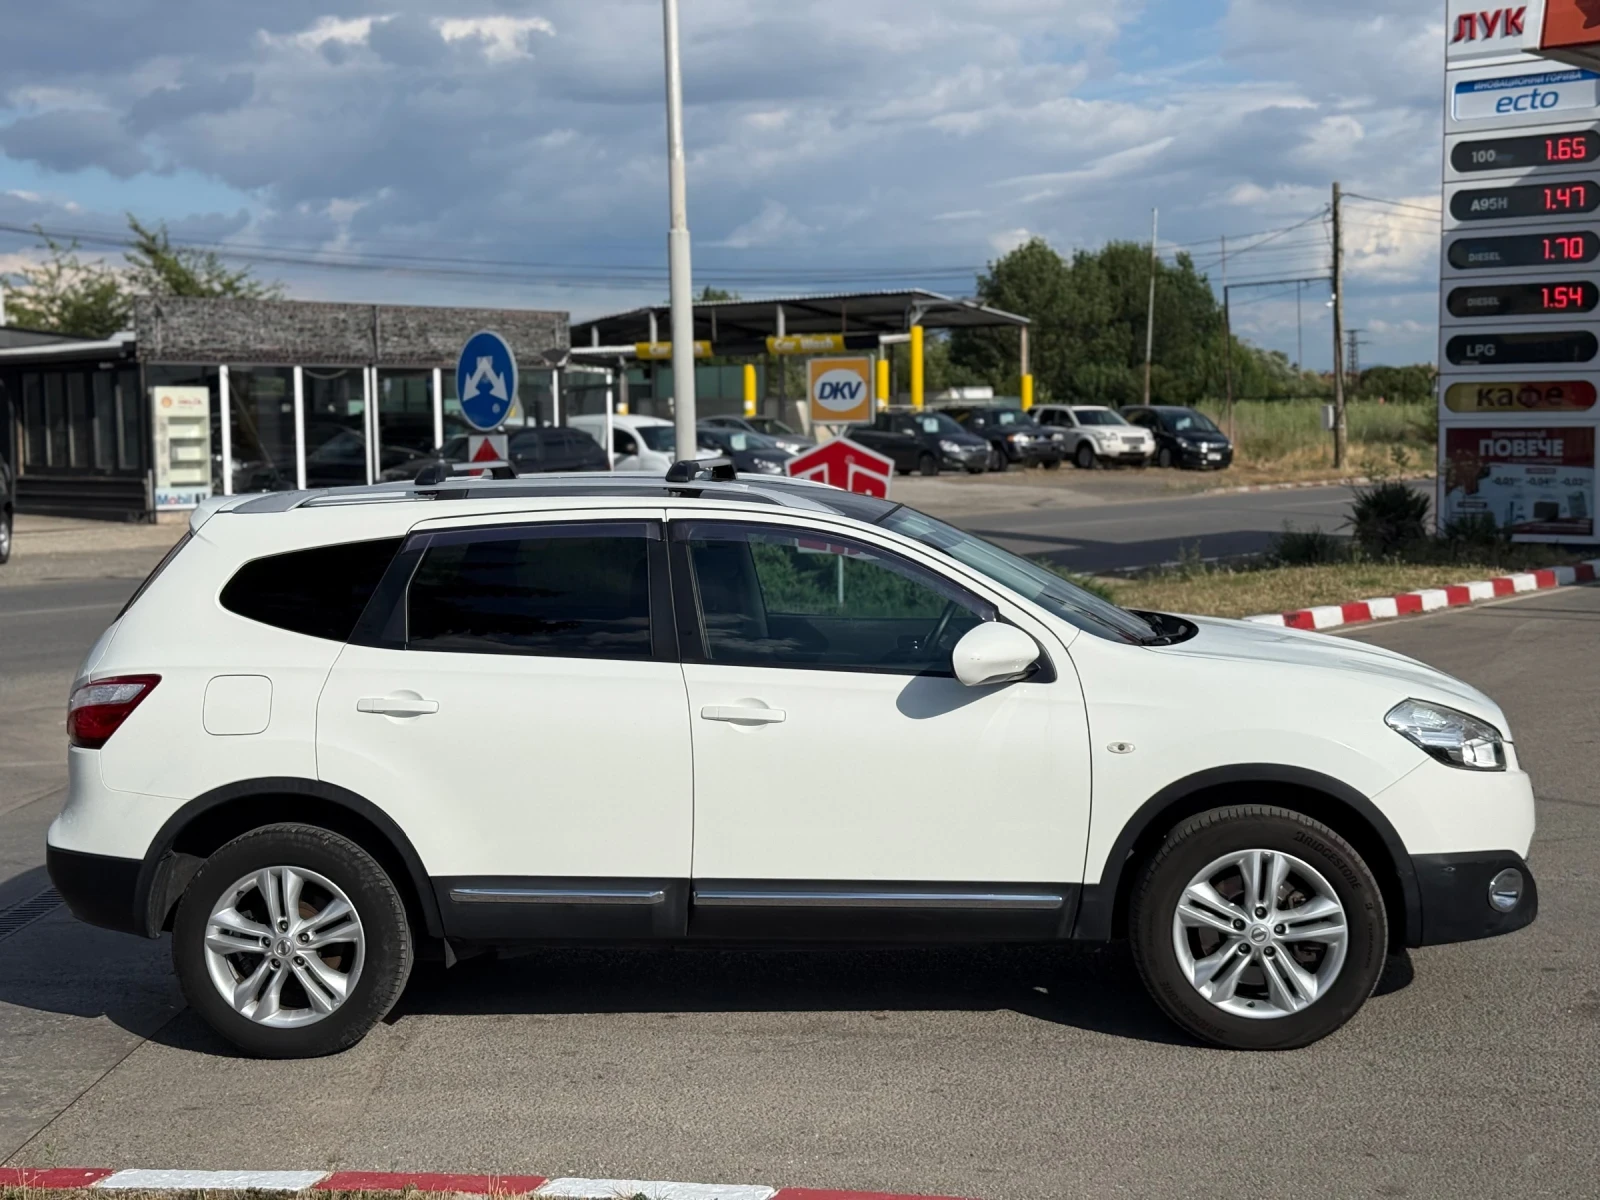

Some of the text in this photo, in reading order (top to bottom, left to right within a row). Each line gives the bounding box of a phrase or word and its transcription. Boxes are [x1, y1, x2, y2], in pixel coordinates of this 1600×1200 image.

[1452, 6, 1527, 43] ЛУК
[1495, 88, 1560, 114] ecto
[1471, 137, 1587, 163] 100 1.65
[1544, 185, 1586, 210] 1.47
[1468, 237, 1584, 262] DIESEL 1.70
[1542, 286, 1583, 309] 1.54
[1465, 344, 1497, 357] LPG
[818, 381, 862, 400] DKV
[1479, 438, 1565, 458] ПОВЕЧЕ
[156, 493, 193, 505] Mobil
[1293, 831, 1363, 891] BRIDGESTONE
